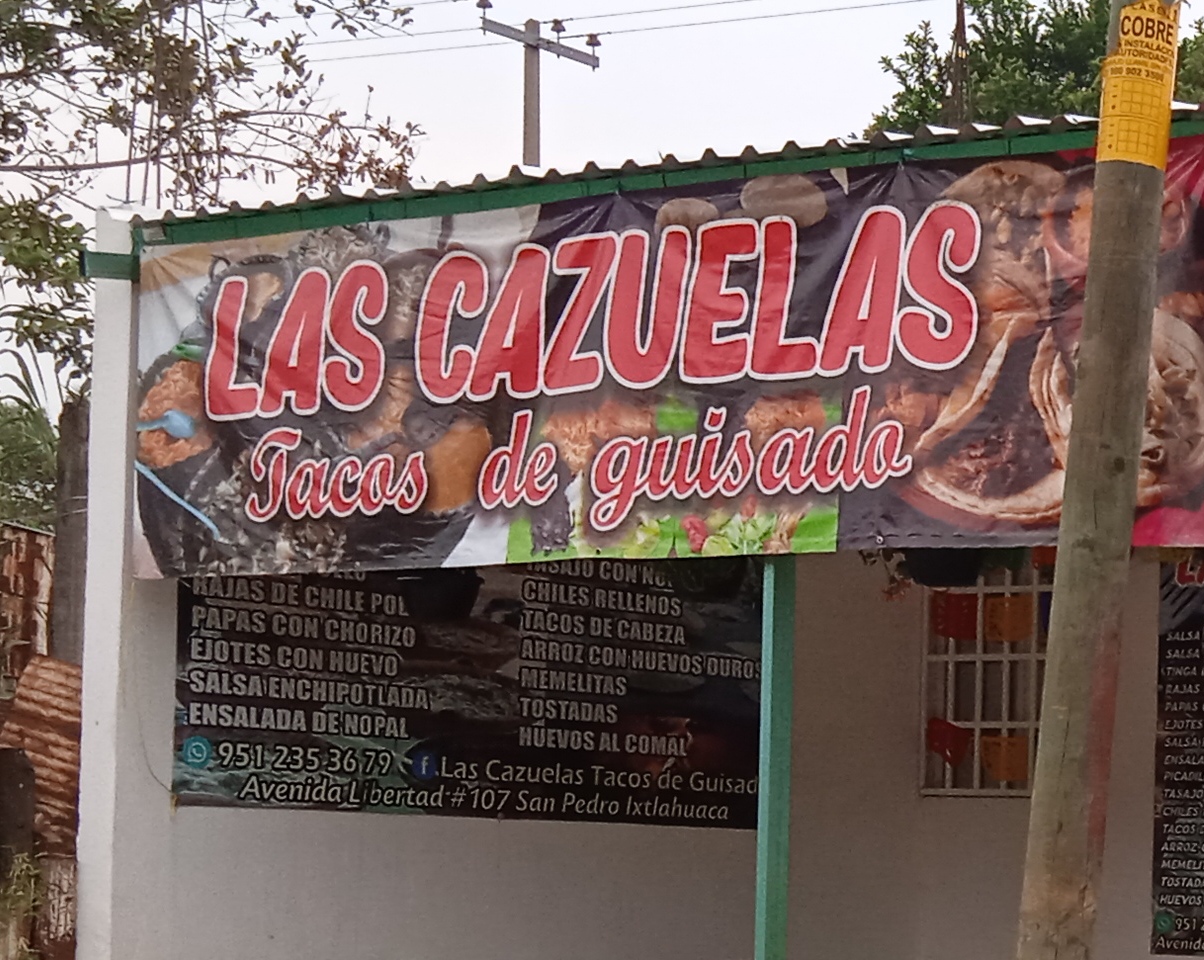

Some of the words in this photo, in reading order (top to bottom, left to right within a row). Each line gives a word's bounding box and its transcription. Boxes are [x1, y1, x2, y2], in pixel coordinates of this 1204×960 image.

[1121, 16, 1174, 46] COBRE
[204, 260, 389, 422] LAS
[414, 200, 982, 405] CAZUELAS
[244, 427, 428, 523] Tacos
[477, 409, 558, 511] de
[589, 385, 912, 532] guisado
[600, 561, 637, 583] CON
[193, 579, 265, 602] RAJAS
[271, 583, 298, 604] DE
[305, 586, 364, 612] CHILE
[523, 581, 590, 606] CHILES
[595, 589, 682, 617] RELLENOS
[192, 605, 266, 634] PAPAS
[272, 614, 319, 638] CON
[325, 619, 416, 648] CHORIZO
[522, 610, 584, 635] TACOS
[590, 616, 612, 638] DE
[617, 619, 686, 645] CABEZA
[1166, 631, 1200, 641] SALSA
[190, 638, 271, 666] EJOTES
[277, 646, 324, 671] CON
[329, 650, 398, 677] HUEVO
[521, 640, 584, 663] ARROZ
[589, 646, 627, 668] CON
[632, 651, 703, 674] HUEVOS
[1165, 648, 1200, 659] SALSA
[521, 669, 627, 695] MEMELITAS
[1166, 666, 1197, 677] TINGA
[189, 670, 264, 697] SALSA
[269, 679, 431, 711] ENCHIPOTLADA
[1165, 684, 1200, 694] RAJAS
[520, 698, 618, 723] TOSTADAS
[1165, 702, 1198, 712] PAPAS
[189, 702, 307, 732] ENSALADA
[312, 712, 341, 734] DE
[343, 713, 410, 738] NOPAL
[1164, 719, 1202, 730] EJOTES
[519, 727, 594, 751] HUEVOS
[599, 734, 620, 752] AL
[625, 734, 687, 756] COMAL
[1164, 737, 1199, 747] SALSA
[218, 743, 263, 768] 951
[273, 746, 320, 769] 235
[327, 750, 357, 772] 36
[361, 752, 392, 775] 79
[442, 757, 478, 780] Las
[486, 760, 584, 785] Cazuelas
[591, 766, 651, 789] Tacos
[657, 769, 682, 791] de
[690, 772, 758, 795] Guisad
[240, 776, 341, 803] Avenida
[350, 778, 444, 807] Libertad
[516, 790, 555, 813] San
[562, 792, 620, 815] Pedro
[626, 796, 729, 820] Ixtlahuaca
[1163, 788, 1203, 799] TASAJO
[1162, 806, 1199, 817] CHILES
[1163, 824, 1195, 834] TACOS
[1161, 842, 1197, 852] ARROZ
[1160, 894, 1202, 905] HUEVOS
[1175, 918, 1197, 930] 951
